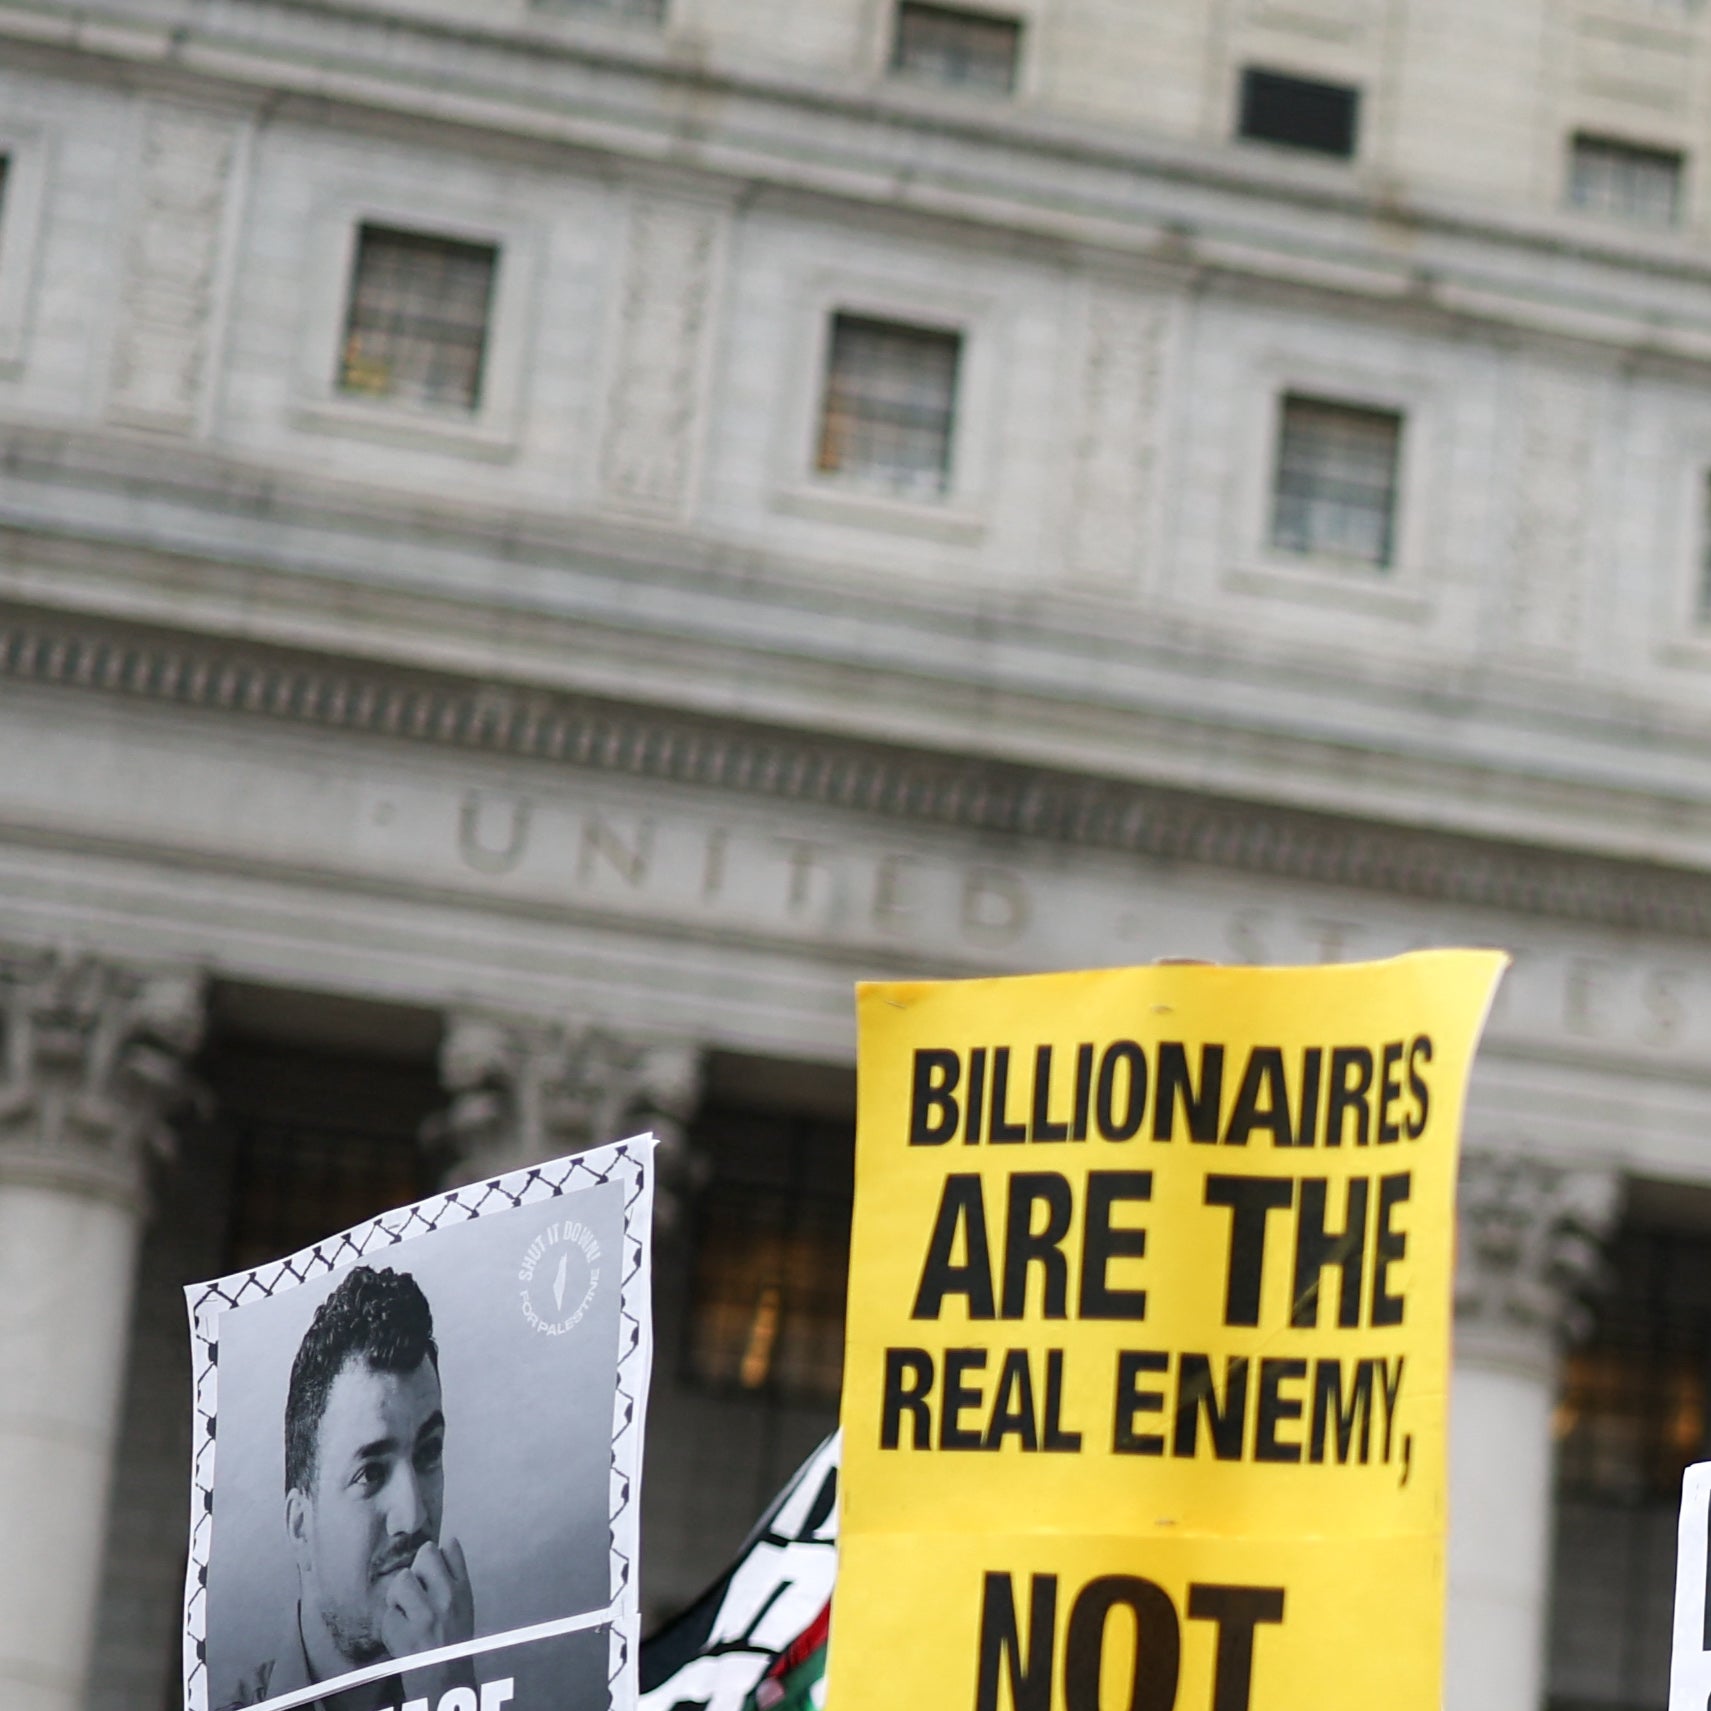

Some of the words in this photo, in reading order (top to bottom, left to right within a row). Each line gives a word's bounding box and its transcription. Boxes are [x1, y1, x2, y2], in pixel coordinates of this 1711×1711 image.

[456, 786, 1031, 950] UNITED
[908, 1033, 1434, 1148] BILLIONAIRES
[518, 1234, 546, 1282] SHUT
[546, 1222, 560, 1246] IT
[519, 1289, 539, 1328] FOR
[536, 1267, 601, 1337] PALESTINE
[909, 1169, 1154, 1322] ARE
[1203, 1169, 1412, 1330] THE
[878, 1347, 1082, 1454] REAL
[1110, 1350, 1413, 1487] ENEMY,
